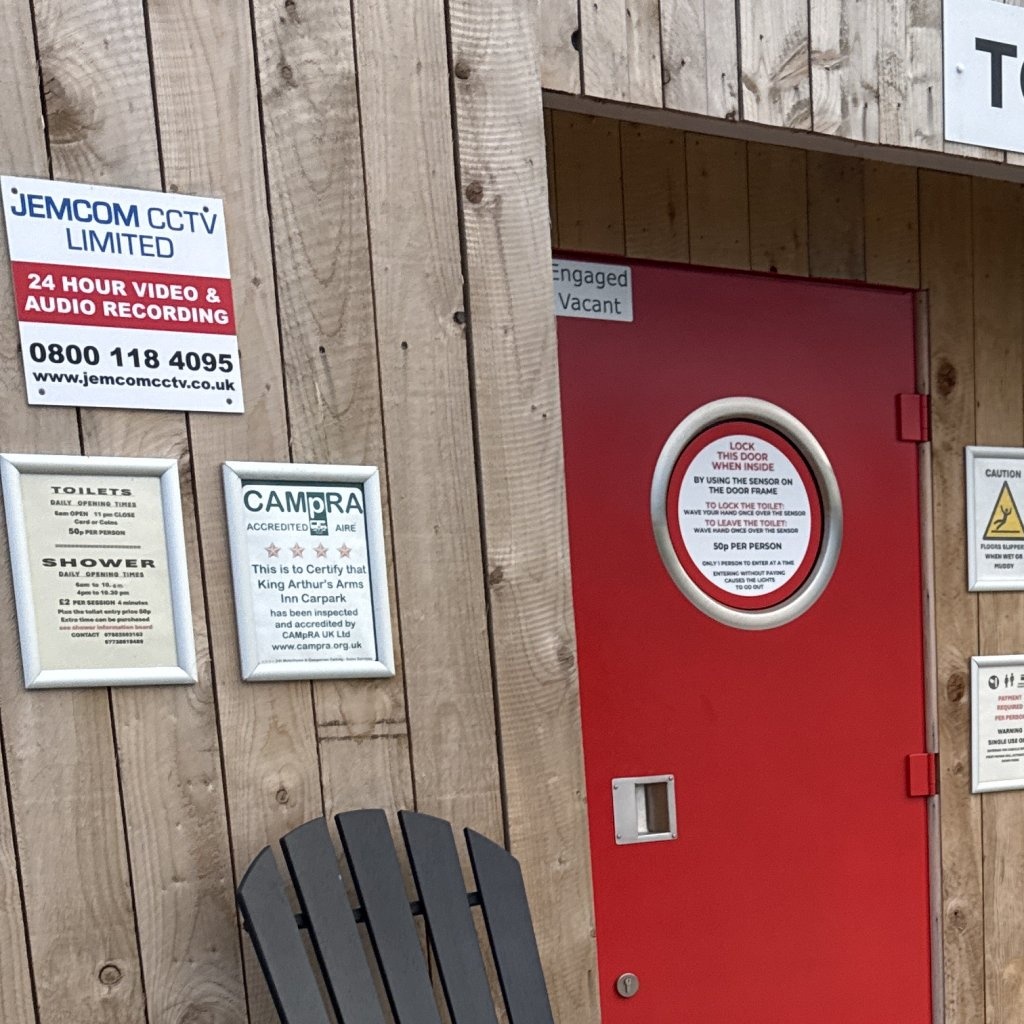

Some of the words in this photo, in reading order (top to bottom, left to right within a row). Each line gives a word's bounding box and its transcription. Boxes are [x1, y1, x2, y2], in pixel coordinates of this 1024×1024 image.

[11, 193, 140, 228] JEMCOM
[147, 207, 217, 234] CCTV
[66, 227, 174, 259] LIMITED
[27, 273, 56, 290] 24
[62, 276, 127, 296] HOUR
[132, 282, 199, 302] VIDEO
[205, 287, 221, 303] &
[558, 292, 622, 315] Vacant
[25, 296, 96, 315] AUDIO
[103, 301, 229, 324] RECORDING
[29, 342, 100, 366] 0800
[110, 347, 160, 368] 118
[169, 351, 234, 373] 4095
[33, 371, 235, 392] www.jemcomcctv.co.uk
[729, 442, 755, 451] LOCK
[717, 451, 738, 461] THIS
[740, 452, 768, 461] DOOR
[712, 462, 742, 471] WHEN
[744, 462, 774, 472] INSIDE
[985, 468, 1022, 478] CAUTION
[693, 476, 704, 484] BY
[707, 476, 730, 485] USING
[733, 477, 747, 485] THE
[749, 477, 779, 485] SENSOR
[781, 478, 793, 486] ON
[50, 486, 132, 497] TOILETS
[708, 486, 724, 494] THE
[751, 487, 778, 495] FRAME
[705, 501, 716, 509] TO
[741, 502, 755, 510] THE
[246, 522, 309, 532] ACCREDITED
[335, 524, 357, 532] AIRE
[718, 519, 742, 527] LEAVE
[713, 542, 729, 551] 50p
[731, 542, 748, 550] PER
[749, 542, 782, 550] PERSON
[42, 558, 156, 568] SHOWER
[251, 564, 277, 574] This
[279, 564, 290, 574] is
[292, 565, 303, 574] to
[306, 564, 344, 577] Certify
[346, 564, 367, 575] that
[257, 580, 285, 591] King
[288, 579, 333, 589] Arthur's
[336, 580, 364, 589] Arms
[280, 594, 299, 603] Inn
[301, 594, 347, 604] Carpark
[270, 608, 287, 617] has
[289, 609, 312, 617] been
[314, 609, 358, 619] inspected
[275, 620, 293, 628] and
[294, 620, 343, 628] accredited
[345, 620, 356, 630] by
[282, 631, 320, 640] CAMpRA
[322, 631, 334, 639] UK
[336, 631, 351, 639] Ltd
[271, 642, 362, 651] www.campra.org.uk
